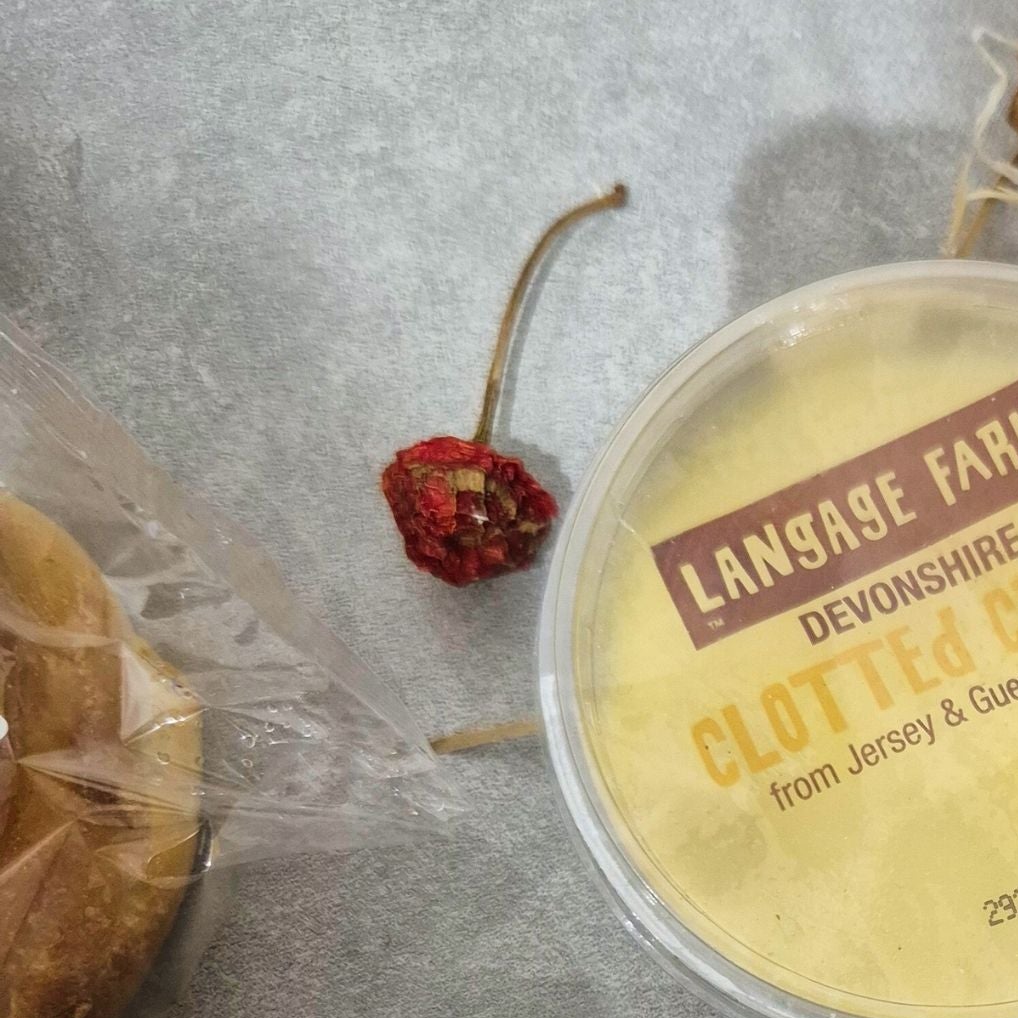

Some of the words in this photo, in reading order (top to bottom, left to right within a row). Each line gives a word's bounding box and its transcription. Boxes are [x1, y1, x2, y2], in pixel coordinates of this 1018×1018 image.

[769, 763, 841, 812] from
[847, 712, 938, 775] Jersey
[941, 698, 968, 727] &
